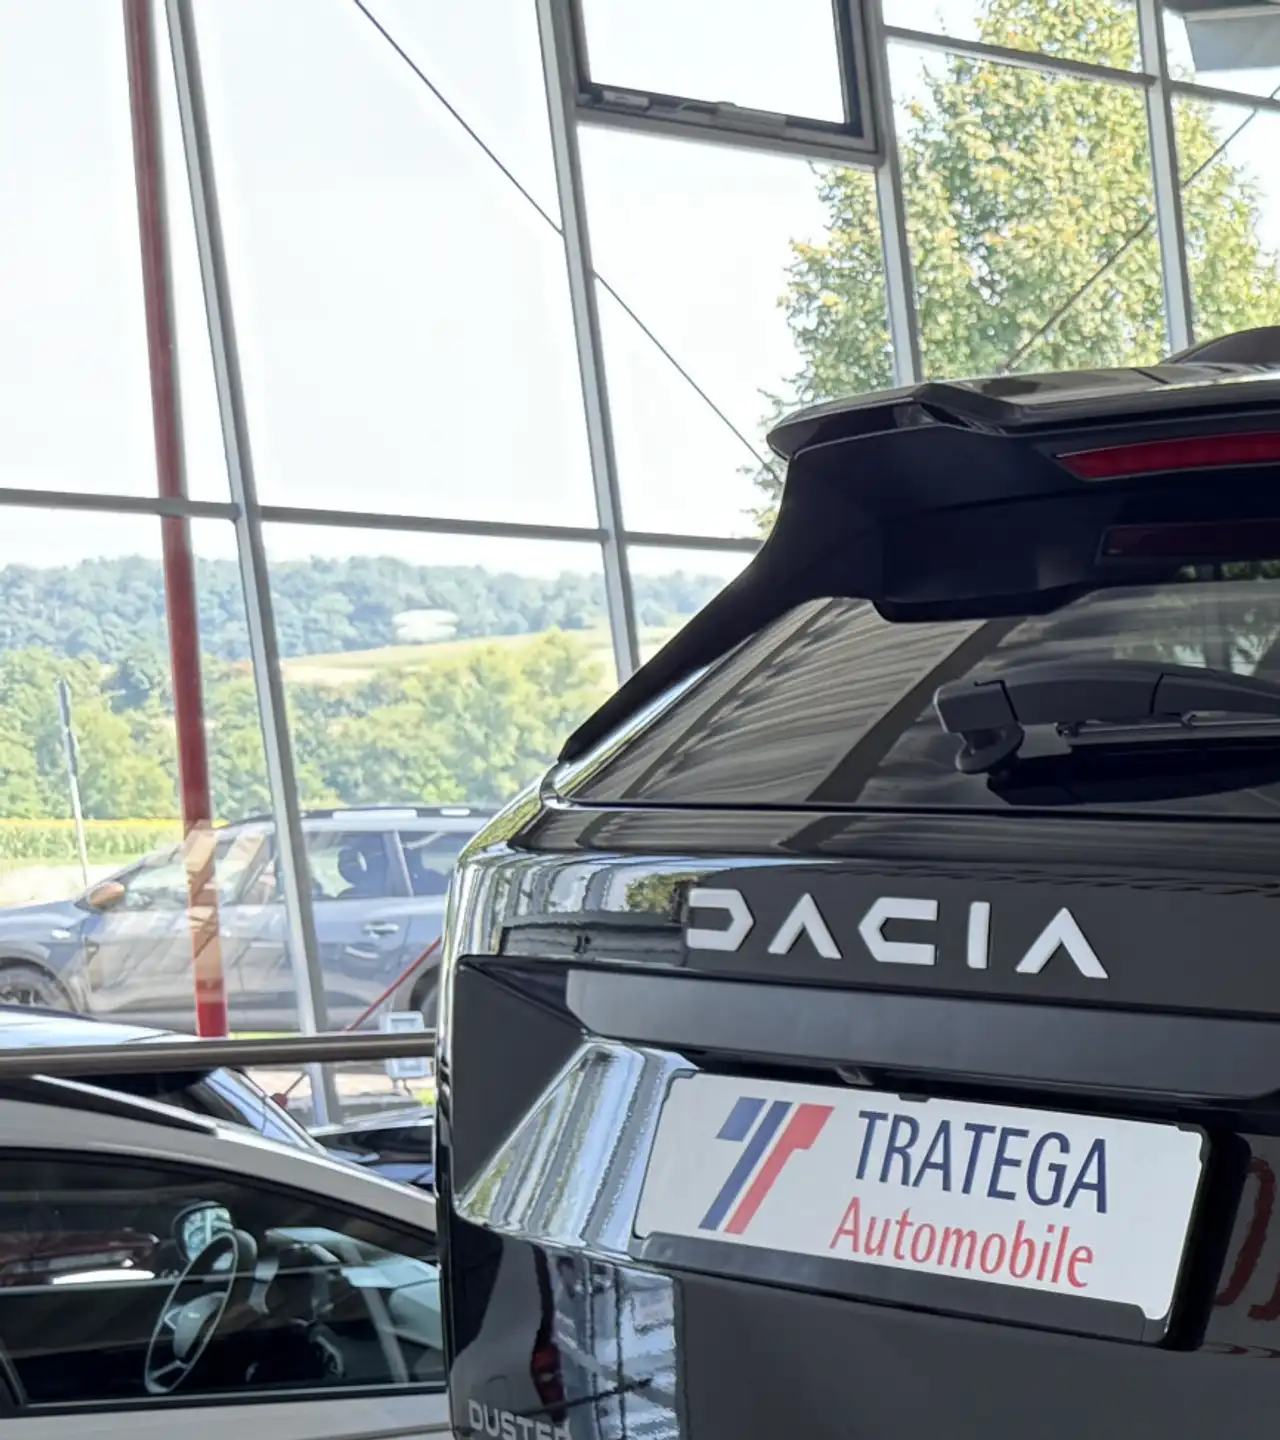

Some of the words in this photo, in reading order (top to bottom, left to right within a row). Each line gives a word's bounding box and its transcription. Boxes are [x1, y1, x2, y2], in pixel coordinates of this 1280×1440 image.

[686, 887, 1109, 979] DACIA
[856, 1109, 1108, 1214] TRATEGA
[830, 1195, 1095, 1289] Automobile
